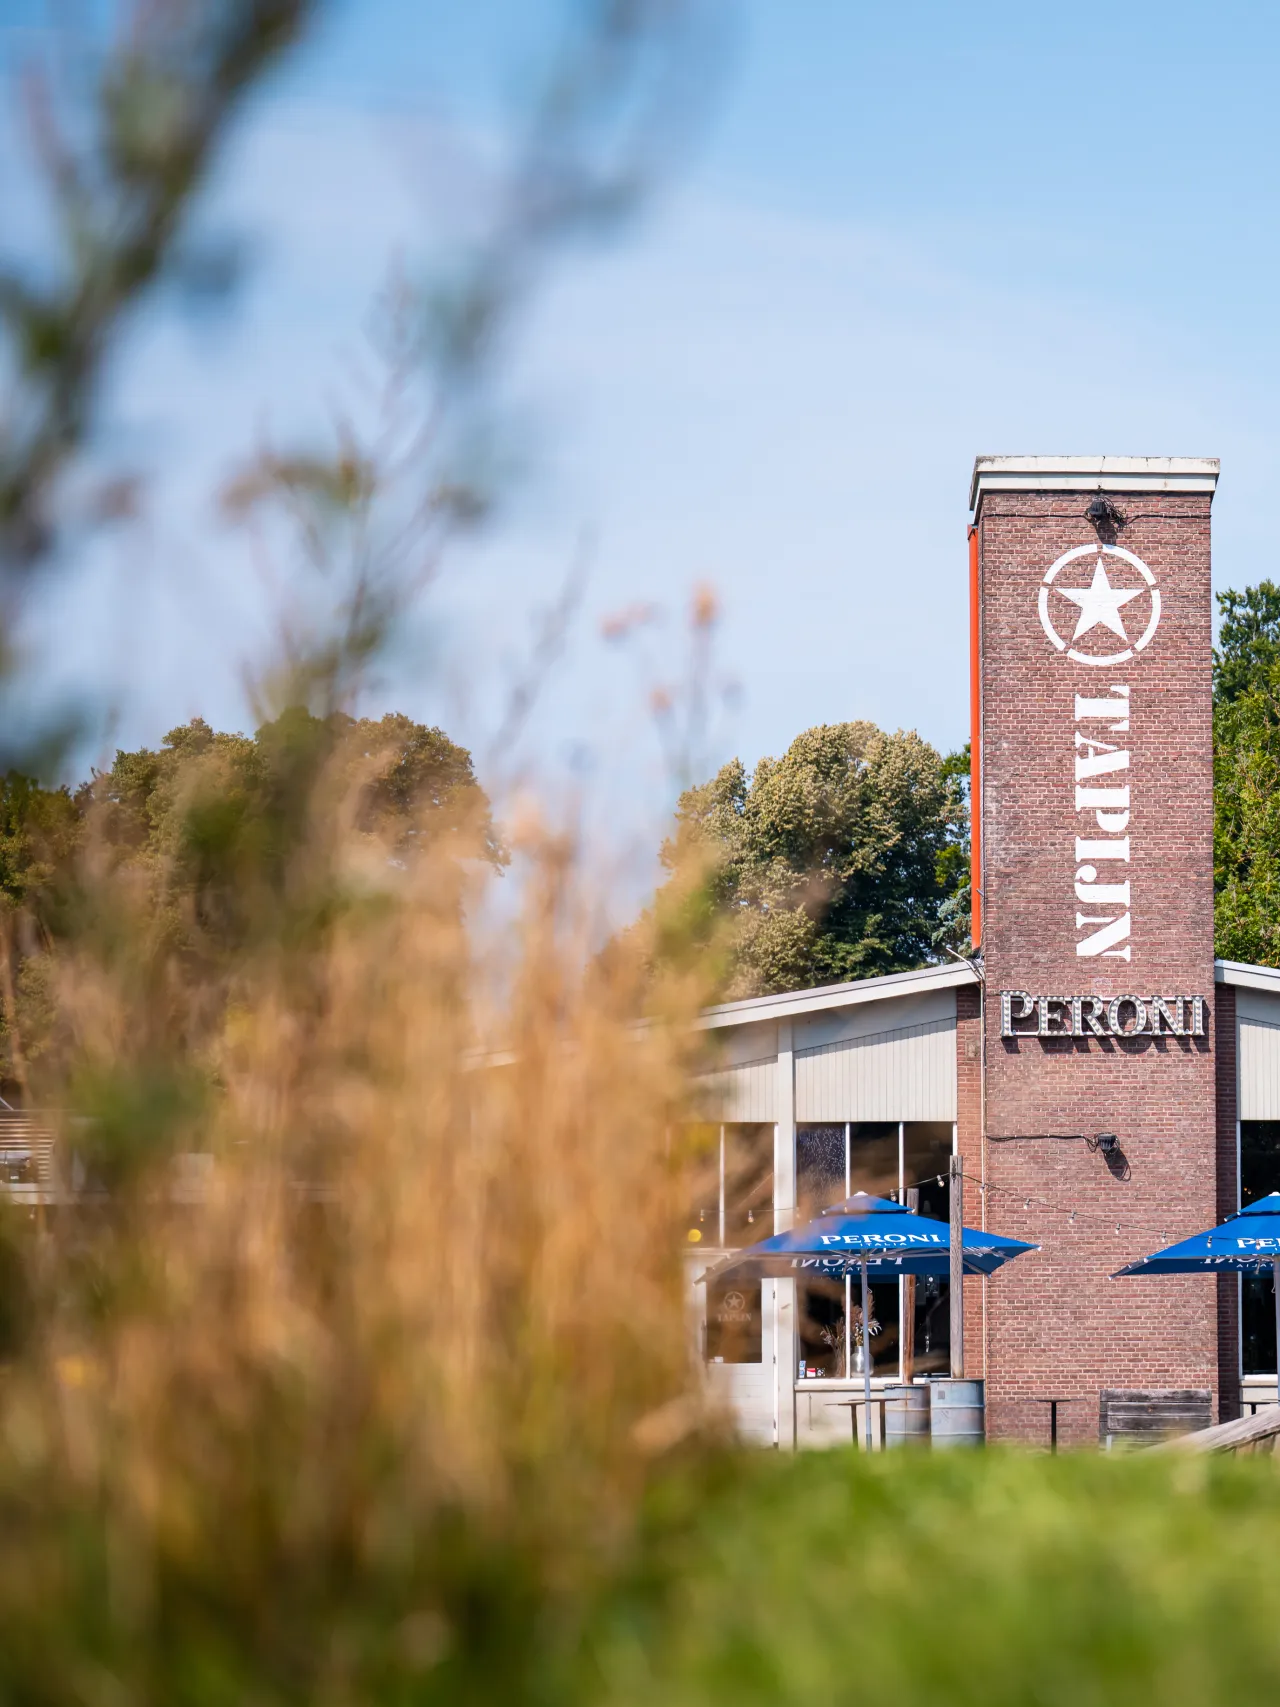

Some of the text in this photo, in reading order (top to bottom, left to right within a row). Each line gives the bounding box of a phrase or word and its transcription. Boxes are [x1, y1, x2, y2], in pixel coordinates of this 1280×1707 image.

[1074, 685, 1130, 962] TAPIJN
[1000, 989, 1206, 1037] PERONI
[820, 1233, 942, 1245] PERONI
